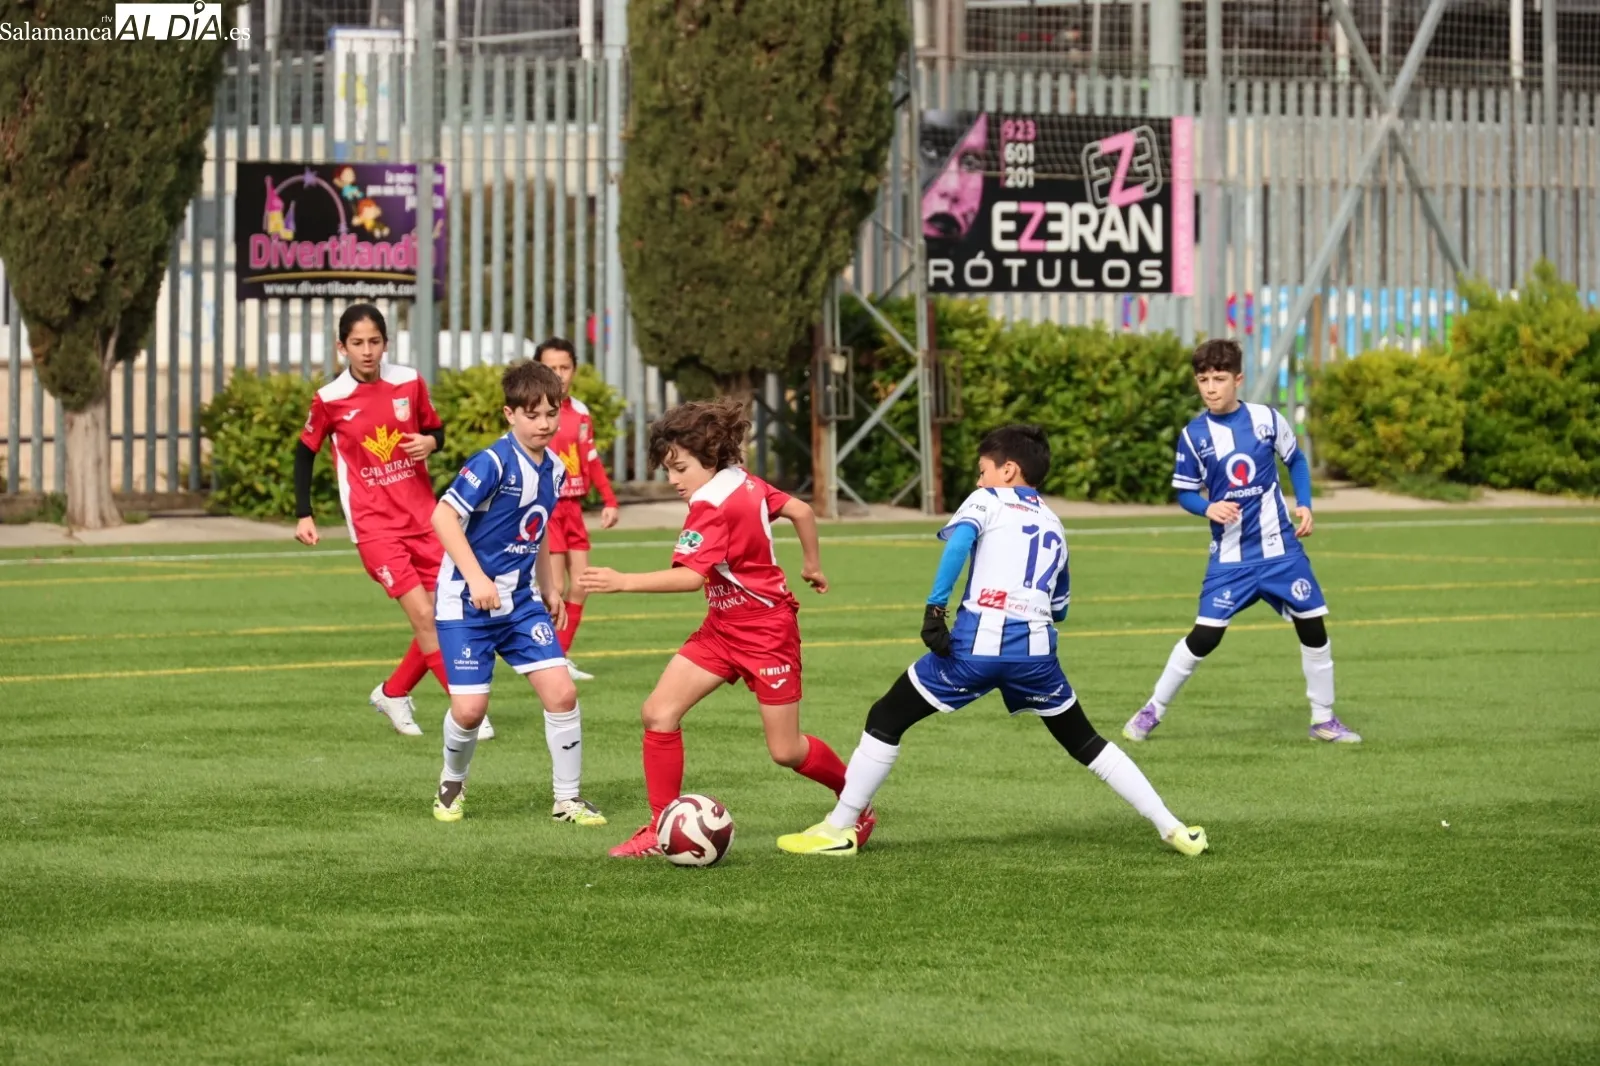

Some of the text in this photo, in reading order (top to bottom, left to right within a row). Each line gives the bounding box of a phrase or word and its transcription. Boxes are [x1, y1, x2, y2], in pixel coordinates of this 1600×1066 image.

[1003, 119, 1036, 141] 923
[1004, 143, 1035, 164] 601
[1004, 166, 1035, 188] 201
[249, 232, 433, 270] Divertilandi
[928, 251, 1163, 288] RÓTULOS
[1022, 523, 1062, 594] 12
